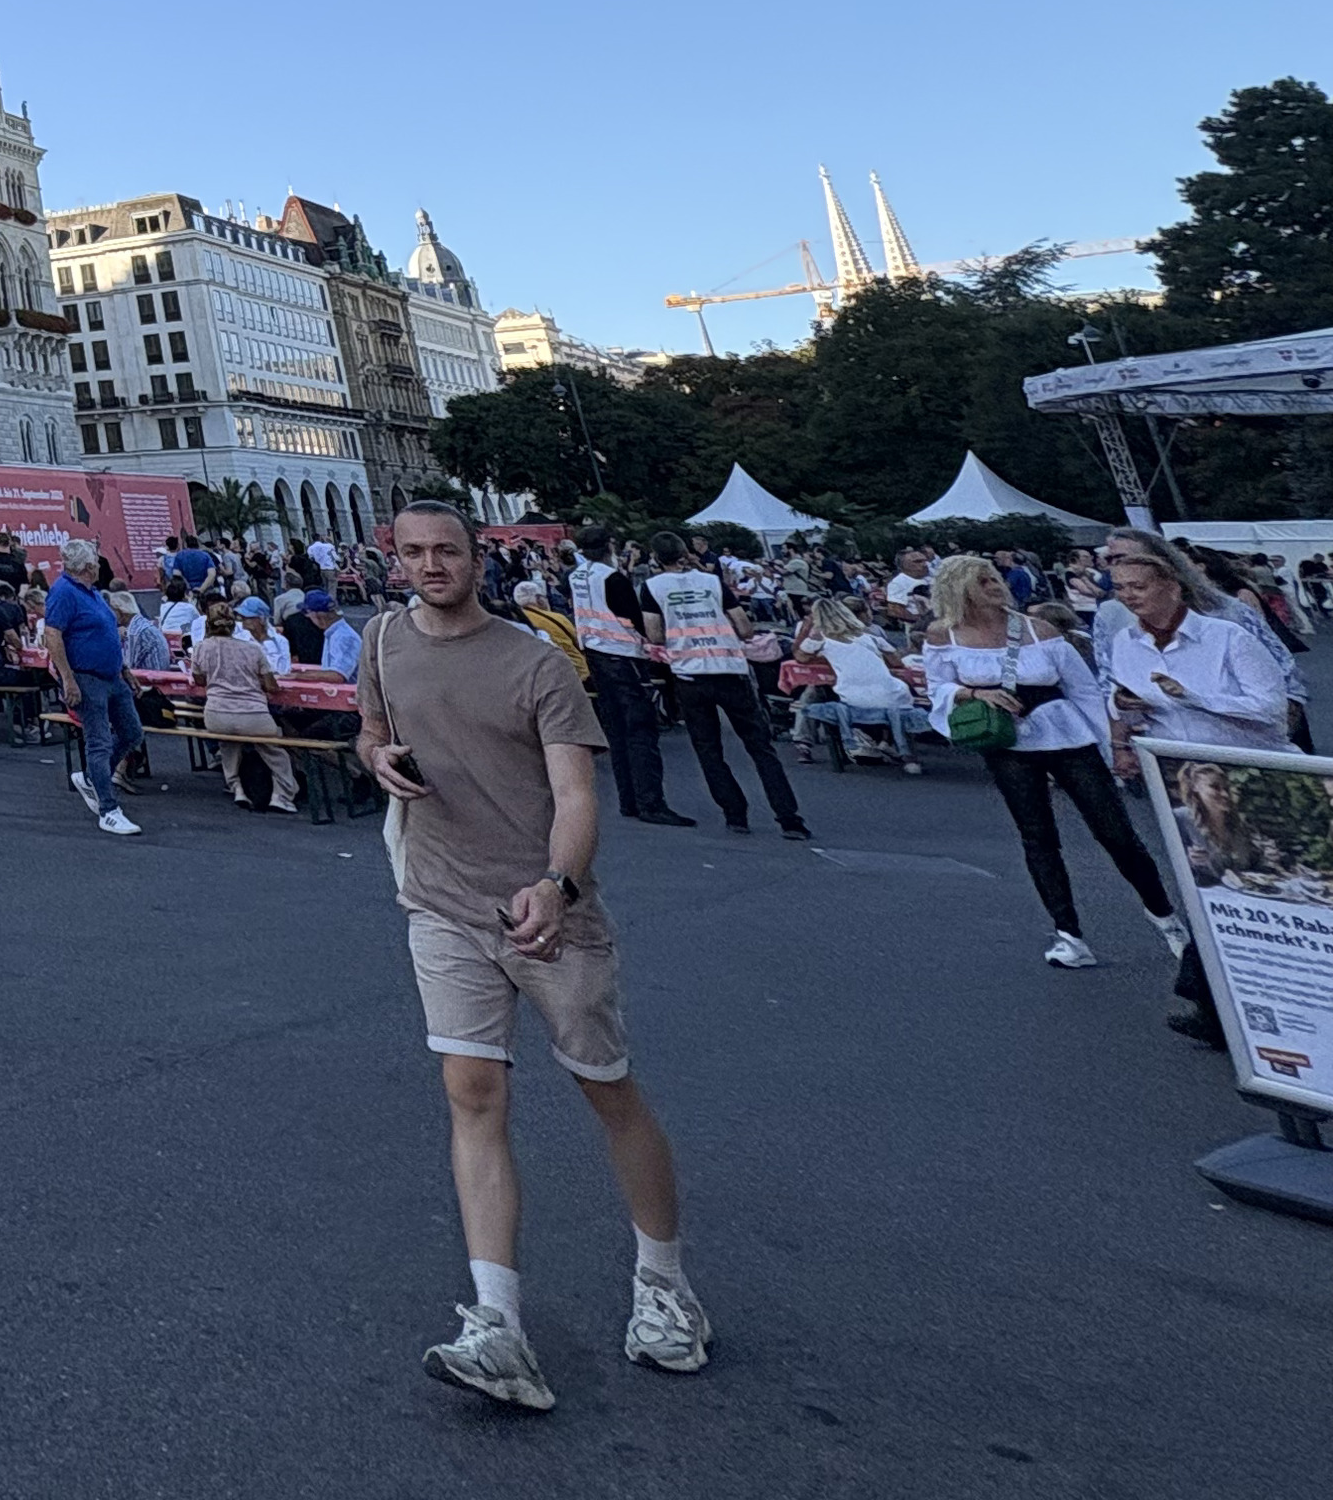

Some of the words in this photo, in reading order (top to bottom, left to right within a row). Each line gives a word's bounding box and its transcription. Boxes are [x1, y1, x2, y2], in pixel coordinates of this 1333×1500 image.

[0, 523, 70, 546] wienliebe
[1210, 901, 1243, 920] Mit
[1244, 907, 1270, 925] 20
[1271, 912, 1290, 929] %
[1215, 922, 1320, 952] schmeckt's
